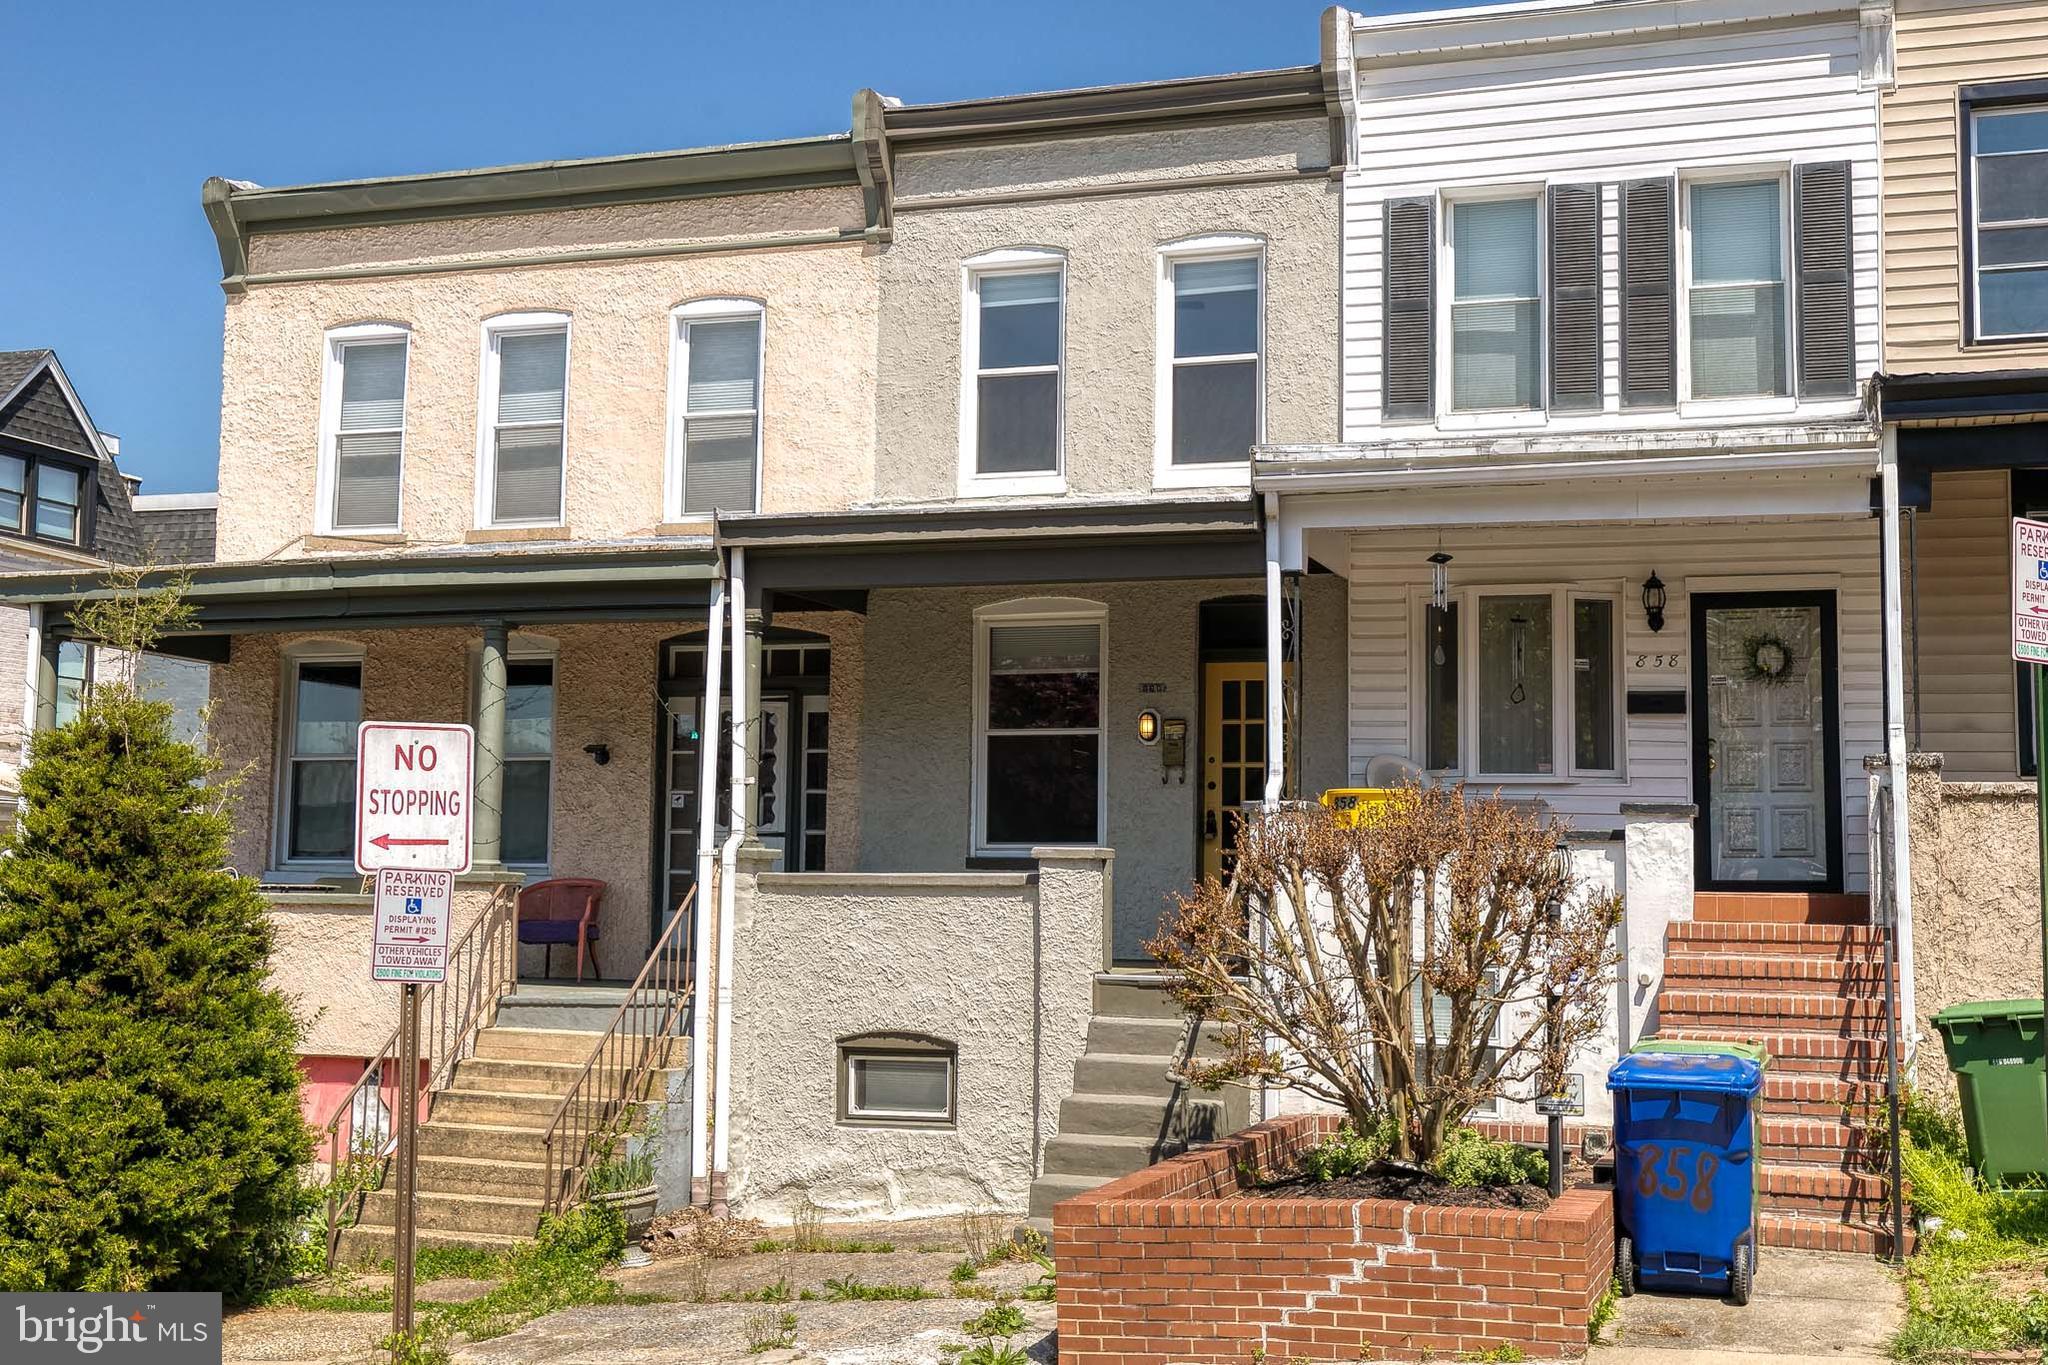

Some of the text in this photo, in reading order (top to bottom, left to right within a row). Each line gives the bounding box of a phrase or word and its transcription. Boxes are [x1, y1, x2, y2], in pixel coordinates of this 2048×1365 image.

[2022, 592, 2045, 604] PERMIT
[2019, 617, 2040, 630] OTHER
[2021, 629, 2046, 642] TOWED
[1635, 654, 1679, 668] 858
[394, 744, 437, 771] NO
[368, 789, 461, 816] STOPPING
[384, 872, 447, 886] PARKING
[385, 885, 444, 897] RESERVED
[388, 915, 437, 925] DISPLAYING
[384, 925, 413, 934] PERMIT
[378, 946, 442, 957] OTHER VEHICLES
[381, 956, 438, 966] TOWED AWAY
[1638, 1144, 1719, 1212] 858
